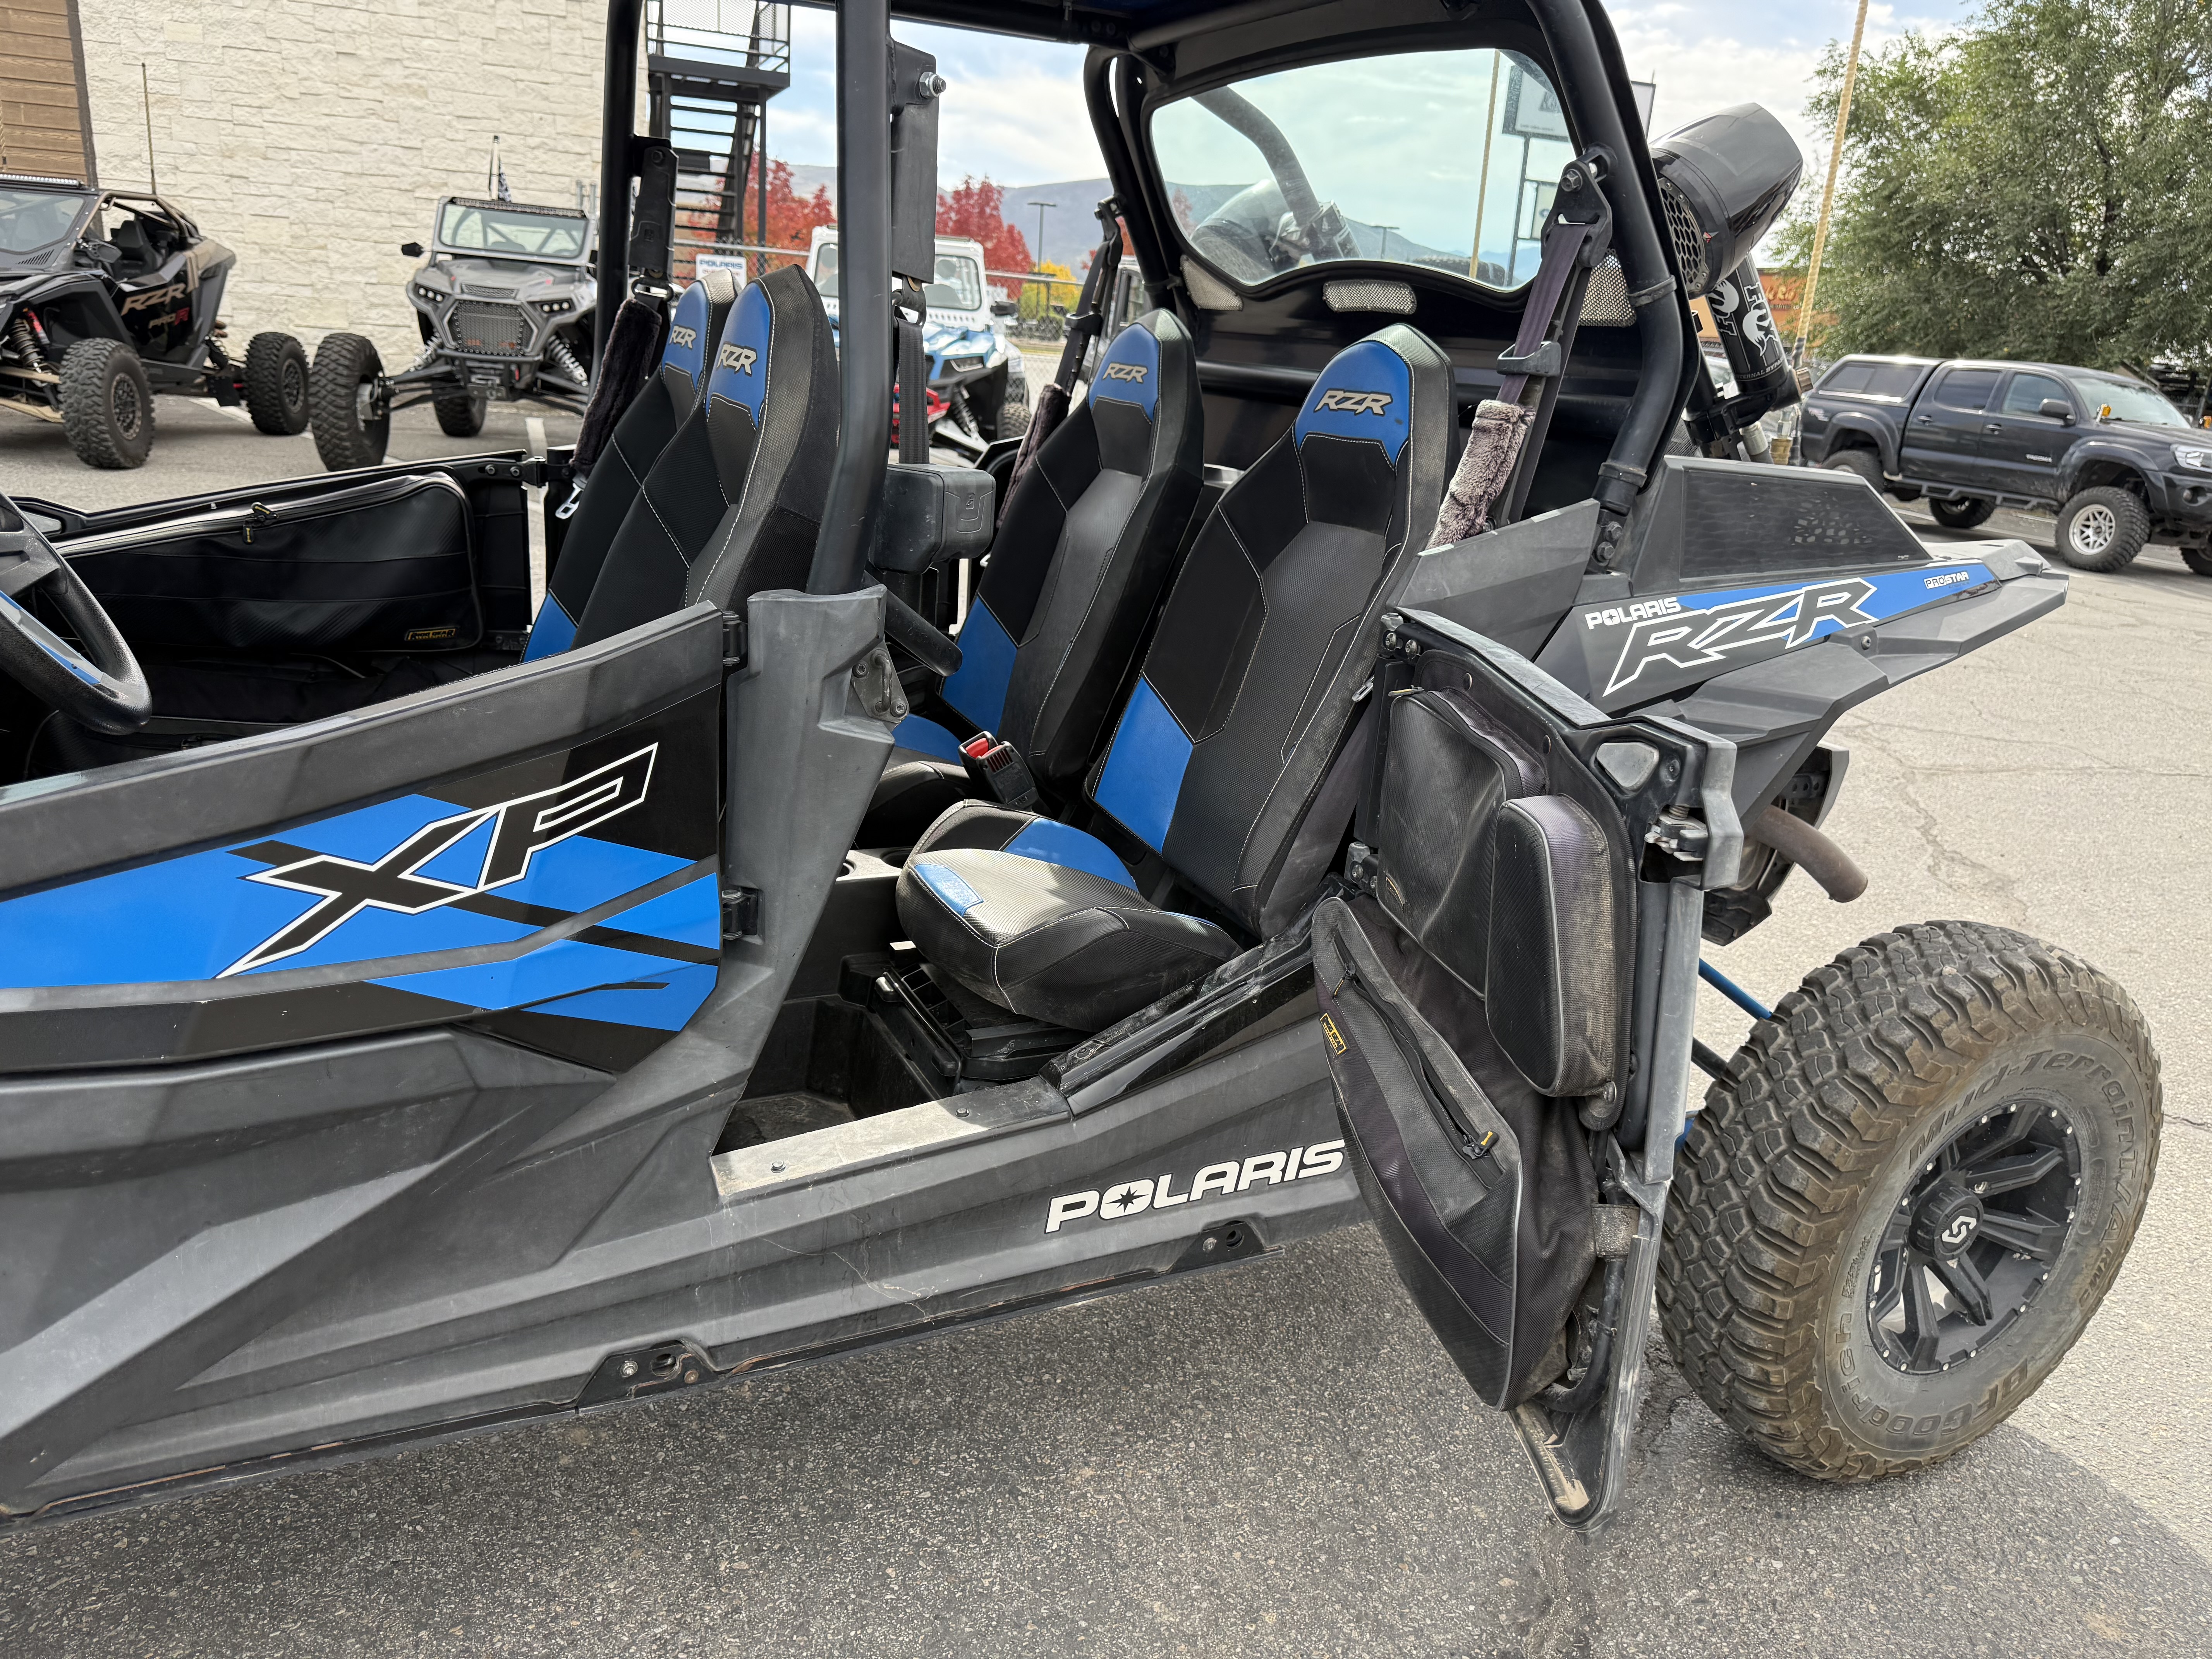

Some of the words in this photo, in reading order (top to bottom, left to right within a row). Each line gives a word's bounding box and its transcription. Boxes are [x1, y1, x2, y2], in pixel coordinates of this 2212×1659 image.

[121, 283, 186, 316] RZR
[1743, 282, 1778, 357] FOX
[670, 325, 696, 349] RZR
[716, 343, 757, 375] RZR
[1103, 362, 1148, 383] RZR
[1314, 389, 1393, 416] RZR
[1924, 571, 1969, 589] PROSTAR
[1585, 597, 1681, 630] POLARIS
[1602, 577, 1880, 697] RZR
[215, 742, 659, 979] XP
[1045, 1139, 1345, 1234] POLARIS
[1835, 1313, 2027, 1435] BFGoodrich
